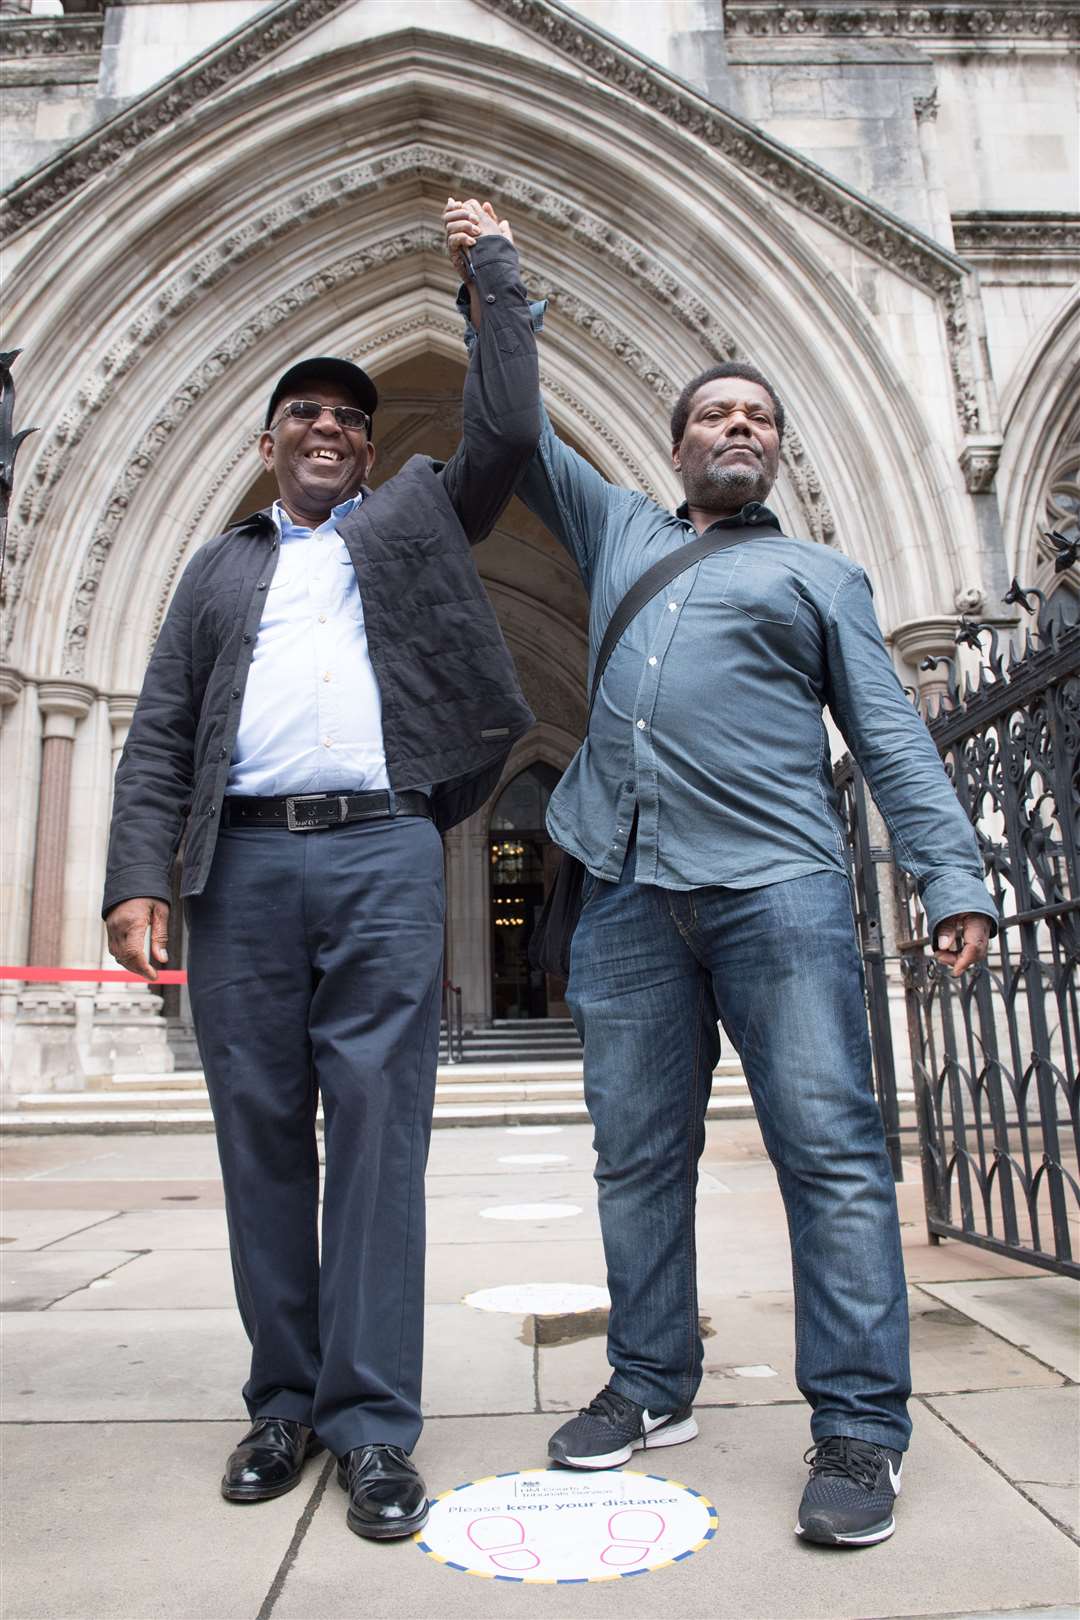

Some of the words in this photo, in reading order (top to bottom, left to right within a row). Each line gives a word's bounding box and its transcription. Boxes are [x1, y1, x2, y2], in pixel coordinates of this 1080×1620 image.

[448, 1504, 500, 1513] Please
[507, 1503, 549, 1512] keep
[554, 1501, 598, 1511] your
[602, 1496, 678, 1507] distance
